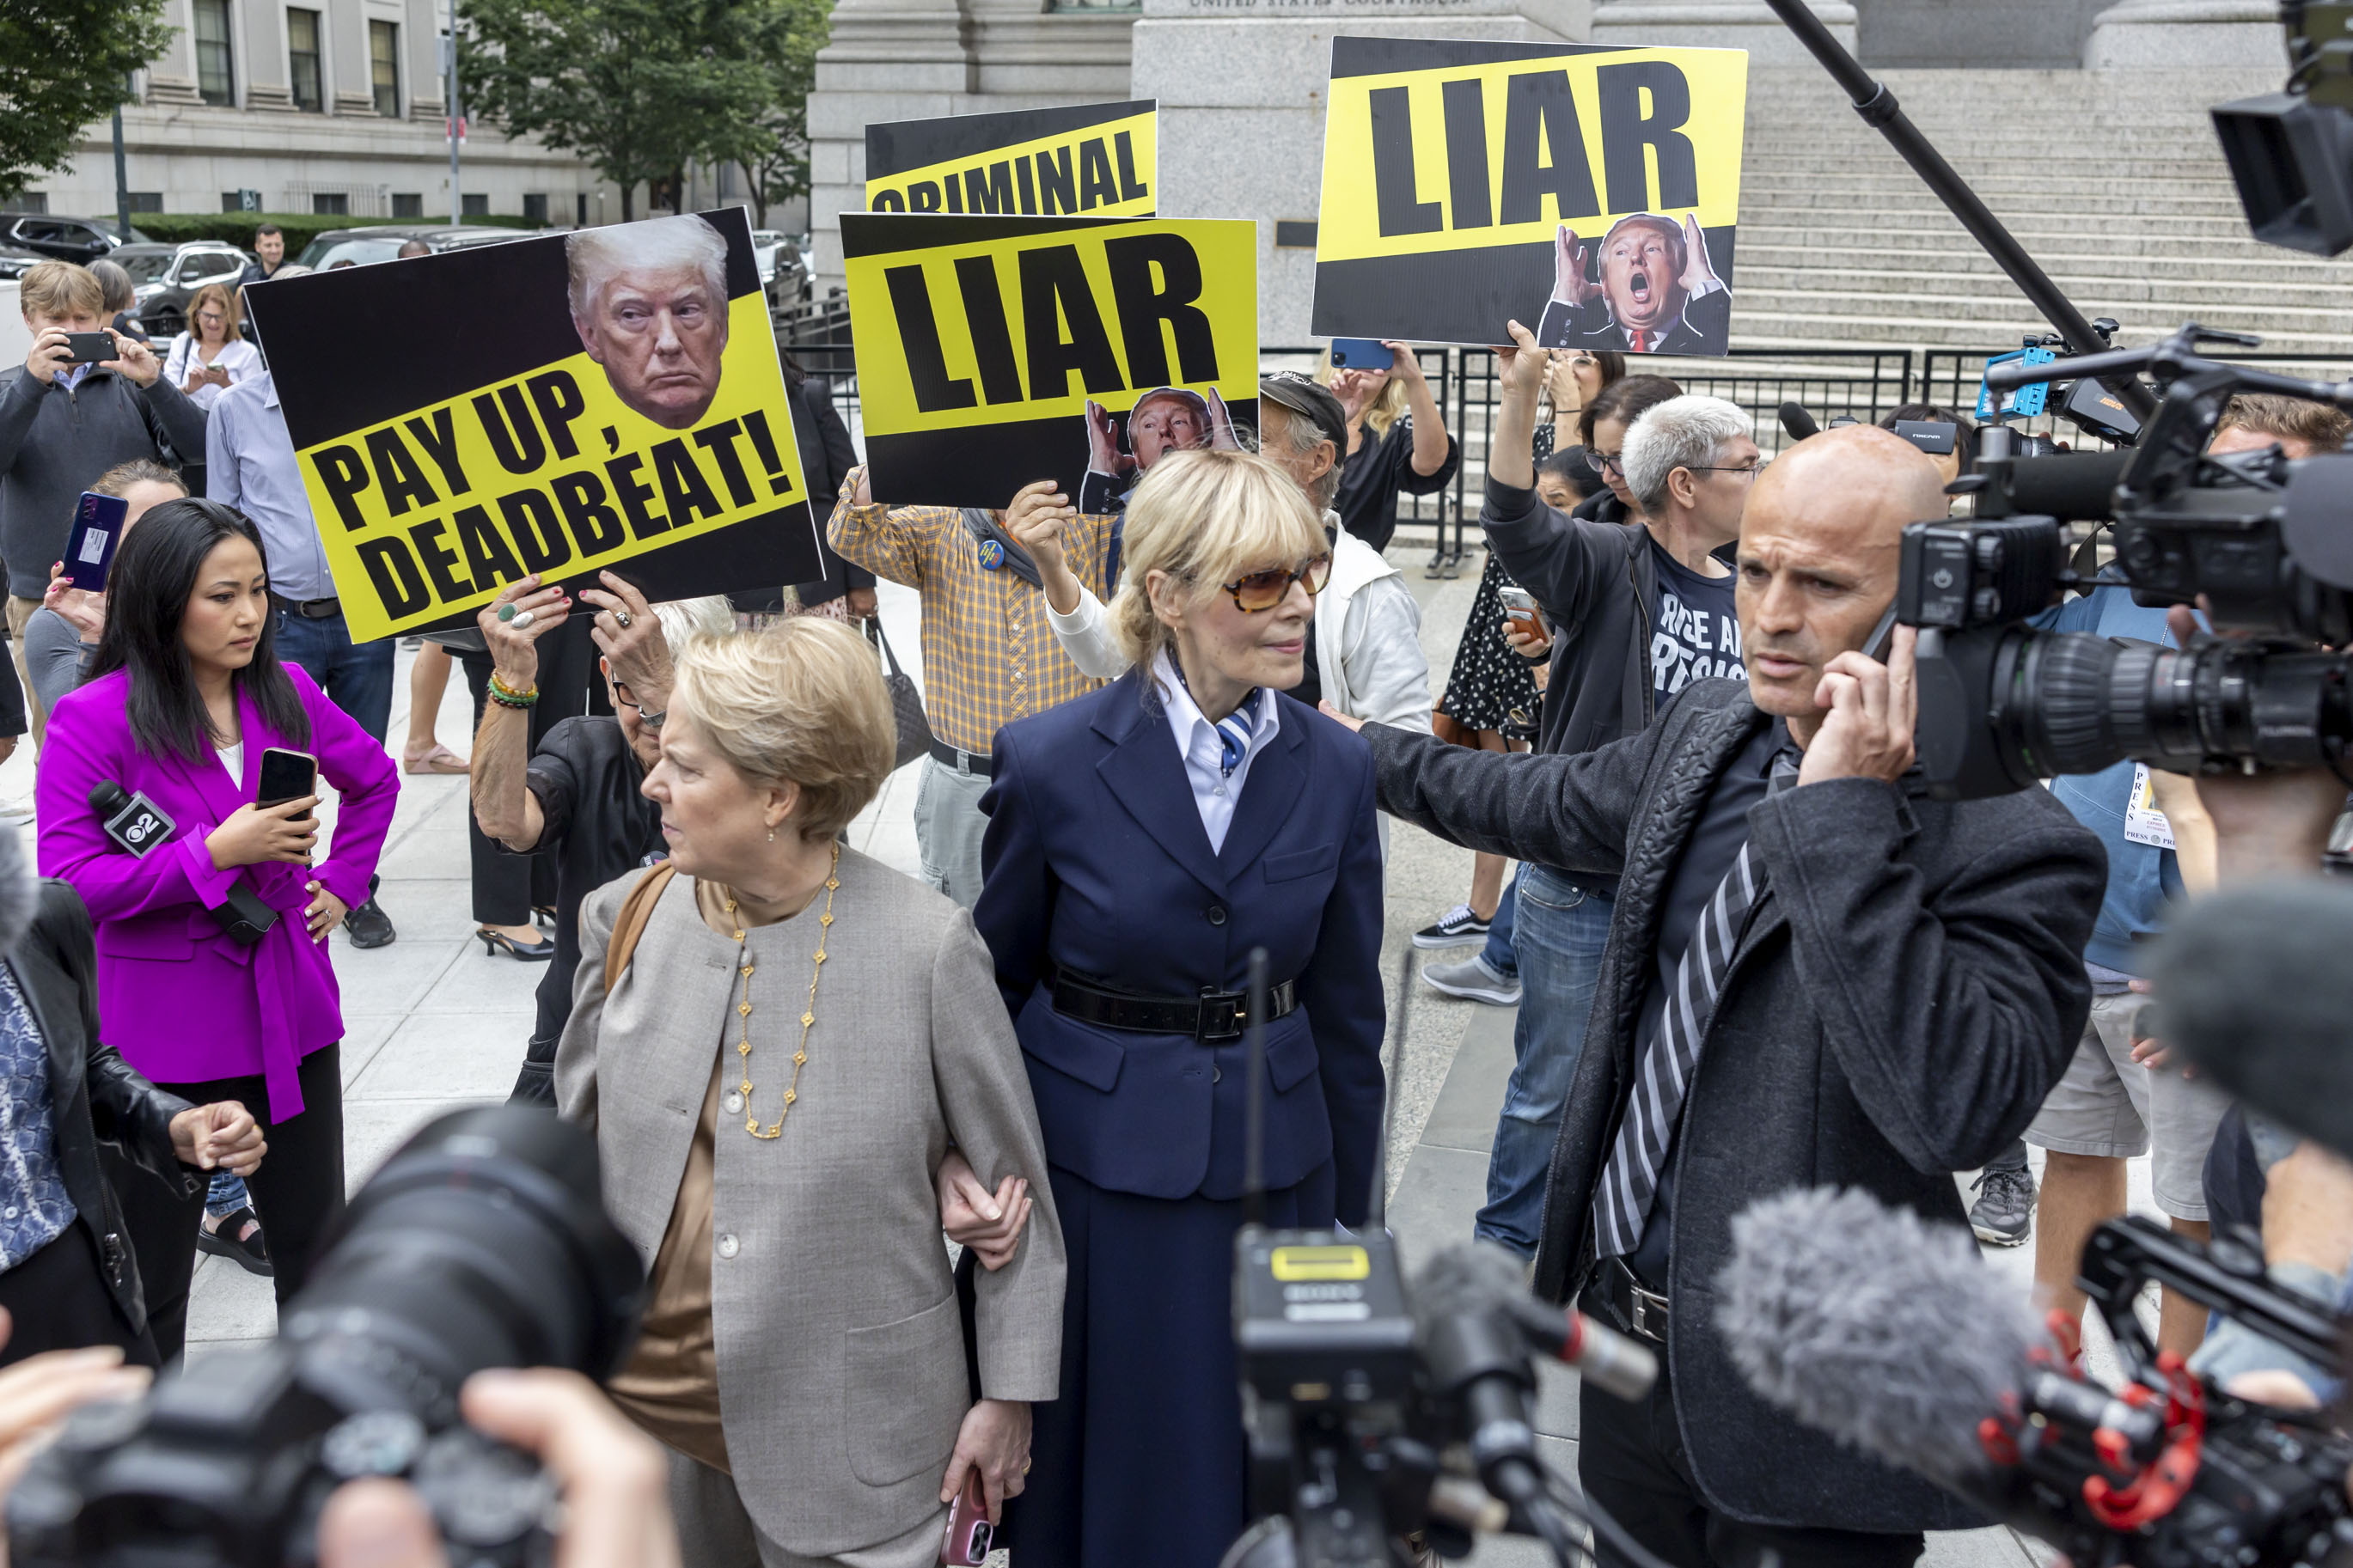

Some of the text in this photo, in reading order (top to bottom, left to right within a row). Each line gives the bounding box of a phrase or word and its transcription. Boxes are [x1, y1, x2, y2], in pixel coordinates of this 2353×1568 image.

[1369, 61, 1699, 237] LIAR
[884, 233, 1220, 413] LIAR
[310, 370, 620, 532] PAY UP,
[354, 409, 793, 621] DEADBEAT!
[2126, 831, 2148, 840] PRESS
[2127, 772, 2143, 821] PRESS
